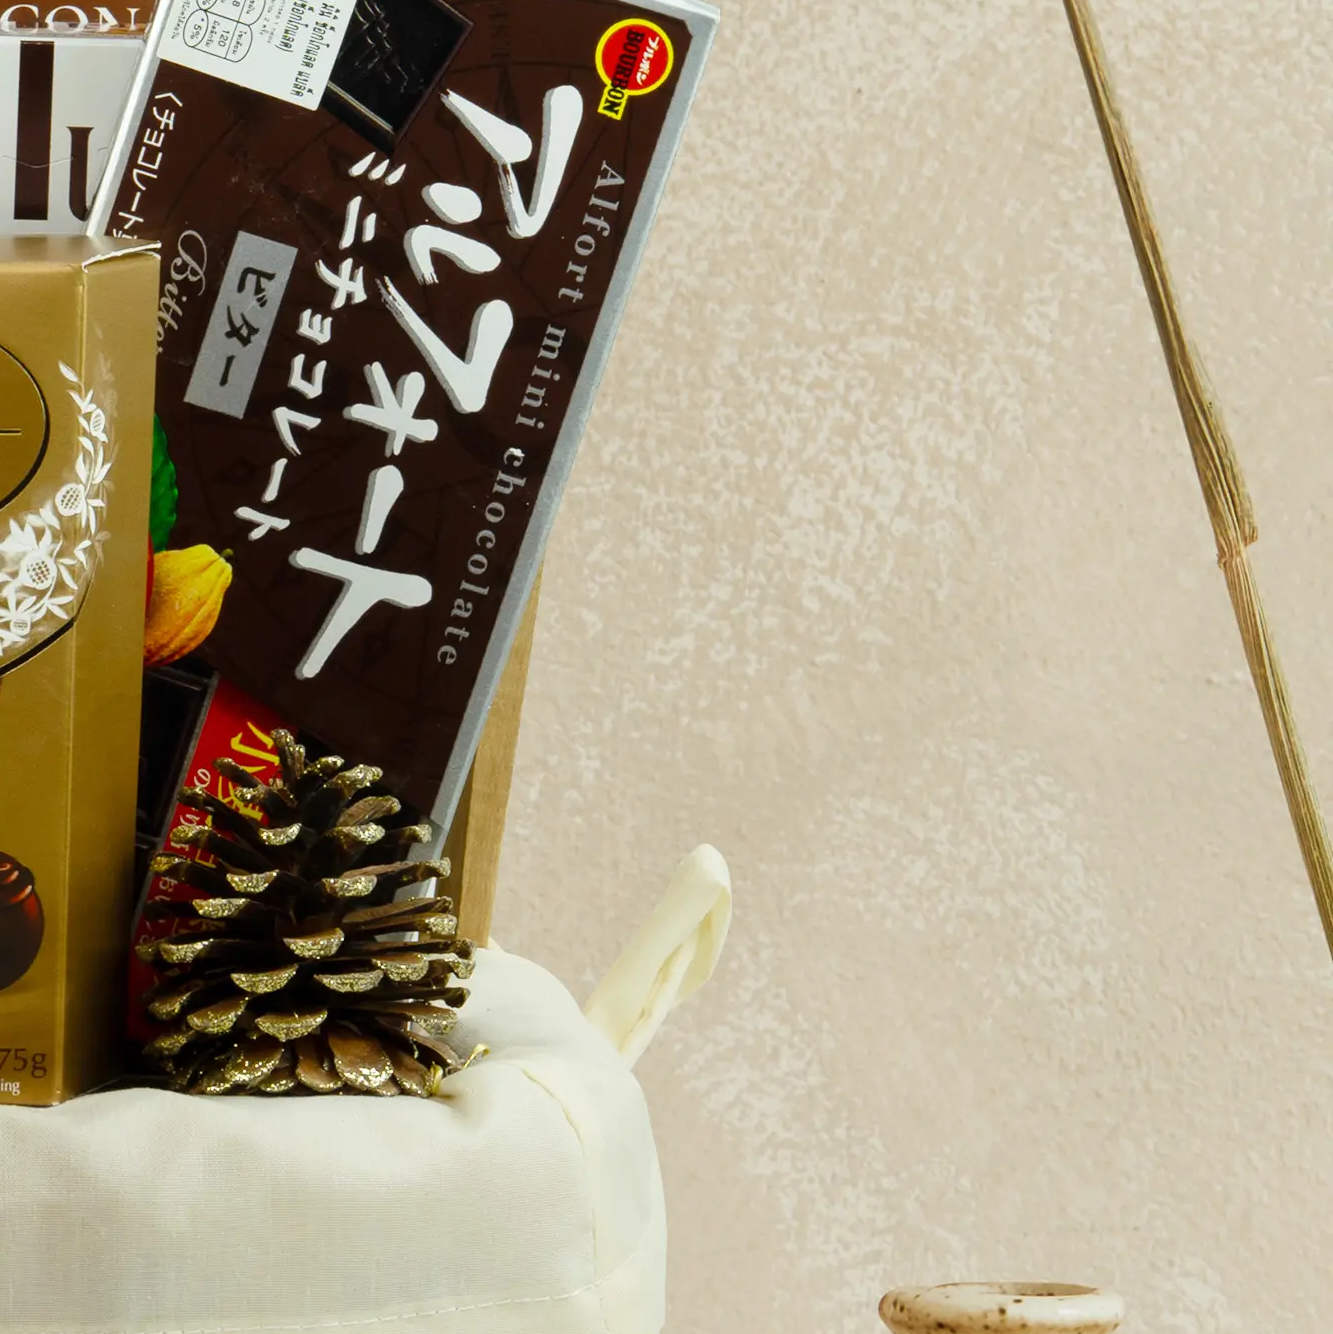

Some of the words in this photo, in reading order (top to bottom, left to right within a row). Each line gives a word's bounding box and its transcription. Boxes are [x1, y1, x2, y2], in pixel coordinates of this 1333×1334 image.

[218, 29, 230, 48] 120
[602, 29, 645, 116] BOURBON
[558, 160, 626, 305] Alfort
[219, 266, 276, 388] ビター
[234, 151, 405, 540] ミニチョコレート
[290, 85, 583, 679] アルフォート
[515, 323, 570, 431] mini
[437, 446, 527, 665] chocolate
